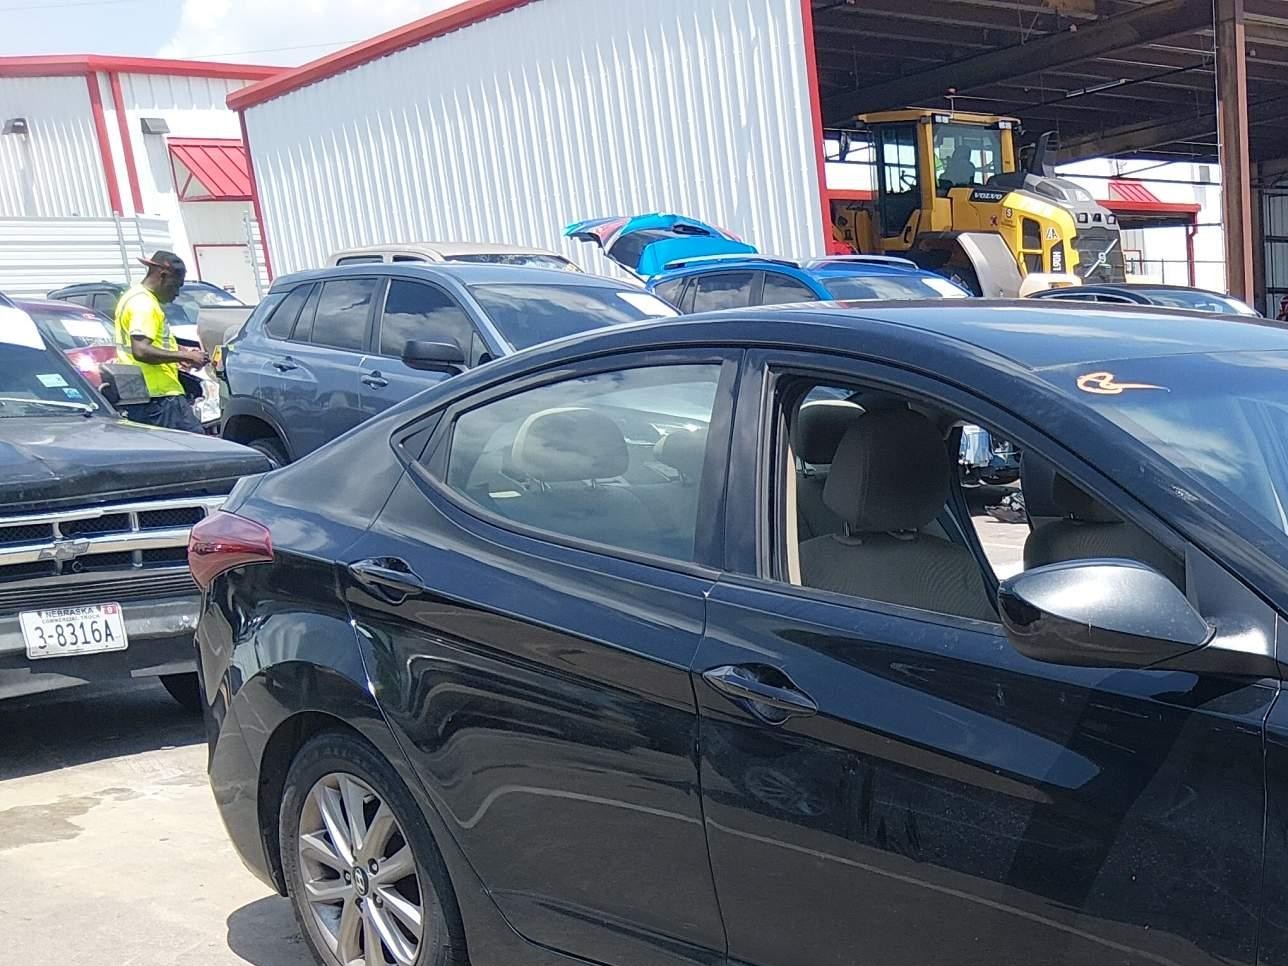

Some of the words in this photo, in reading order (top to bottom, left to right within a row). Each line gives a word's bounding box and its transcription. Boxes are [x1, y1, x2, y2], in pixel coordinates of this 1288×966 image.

[974, 192, 1003, 200] VOLVO
[45, 607, 94, 618] NEBRASKA
[34, 619, 115, 649] 3-8316A
